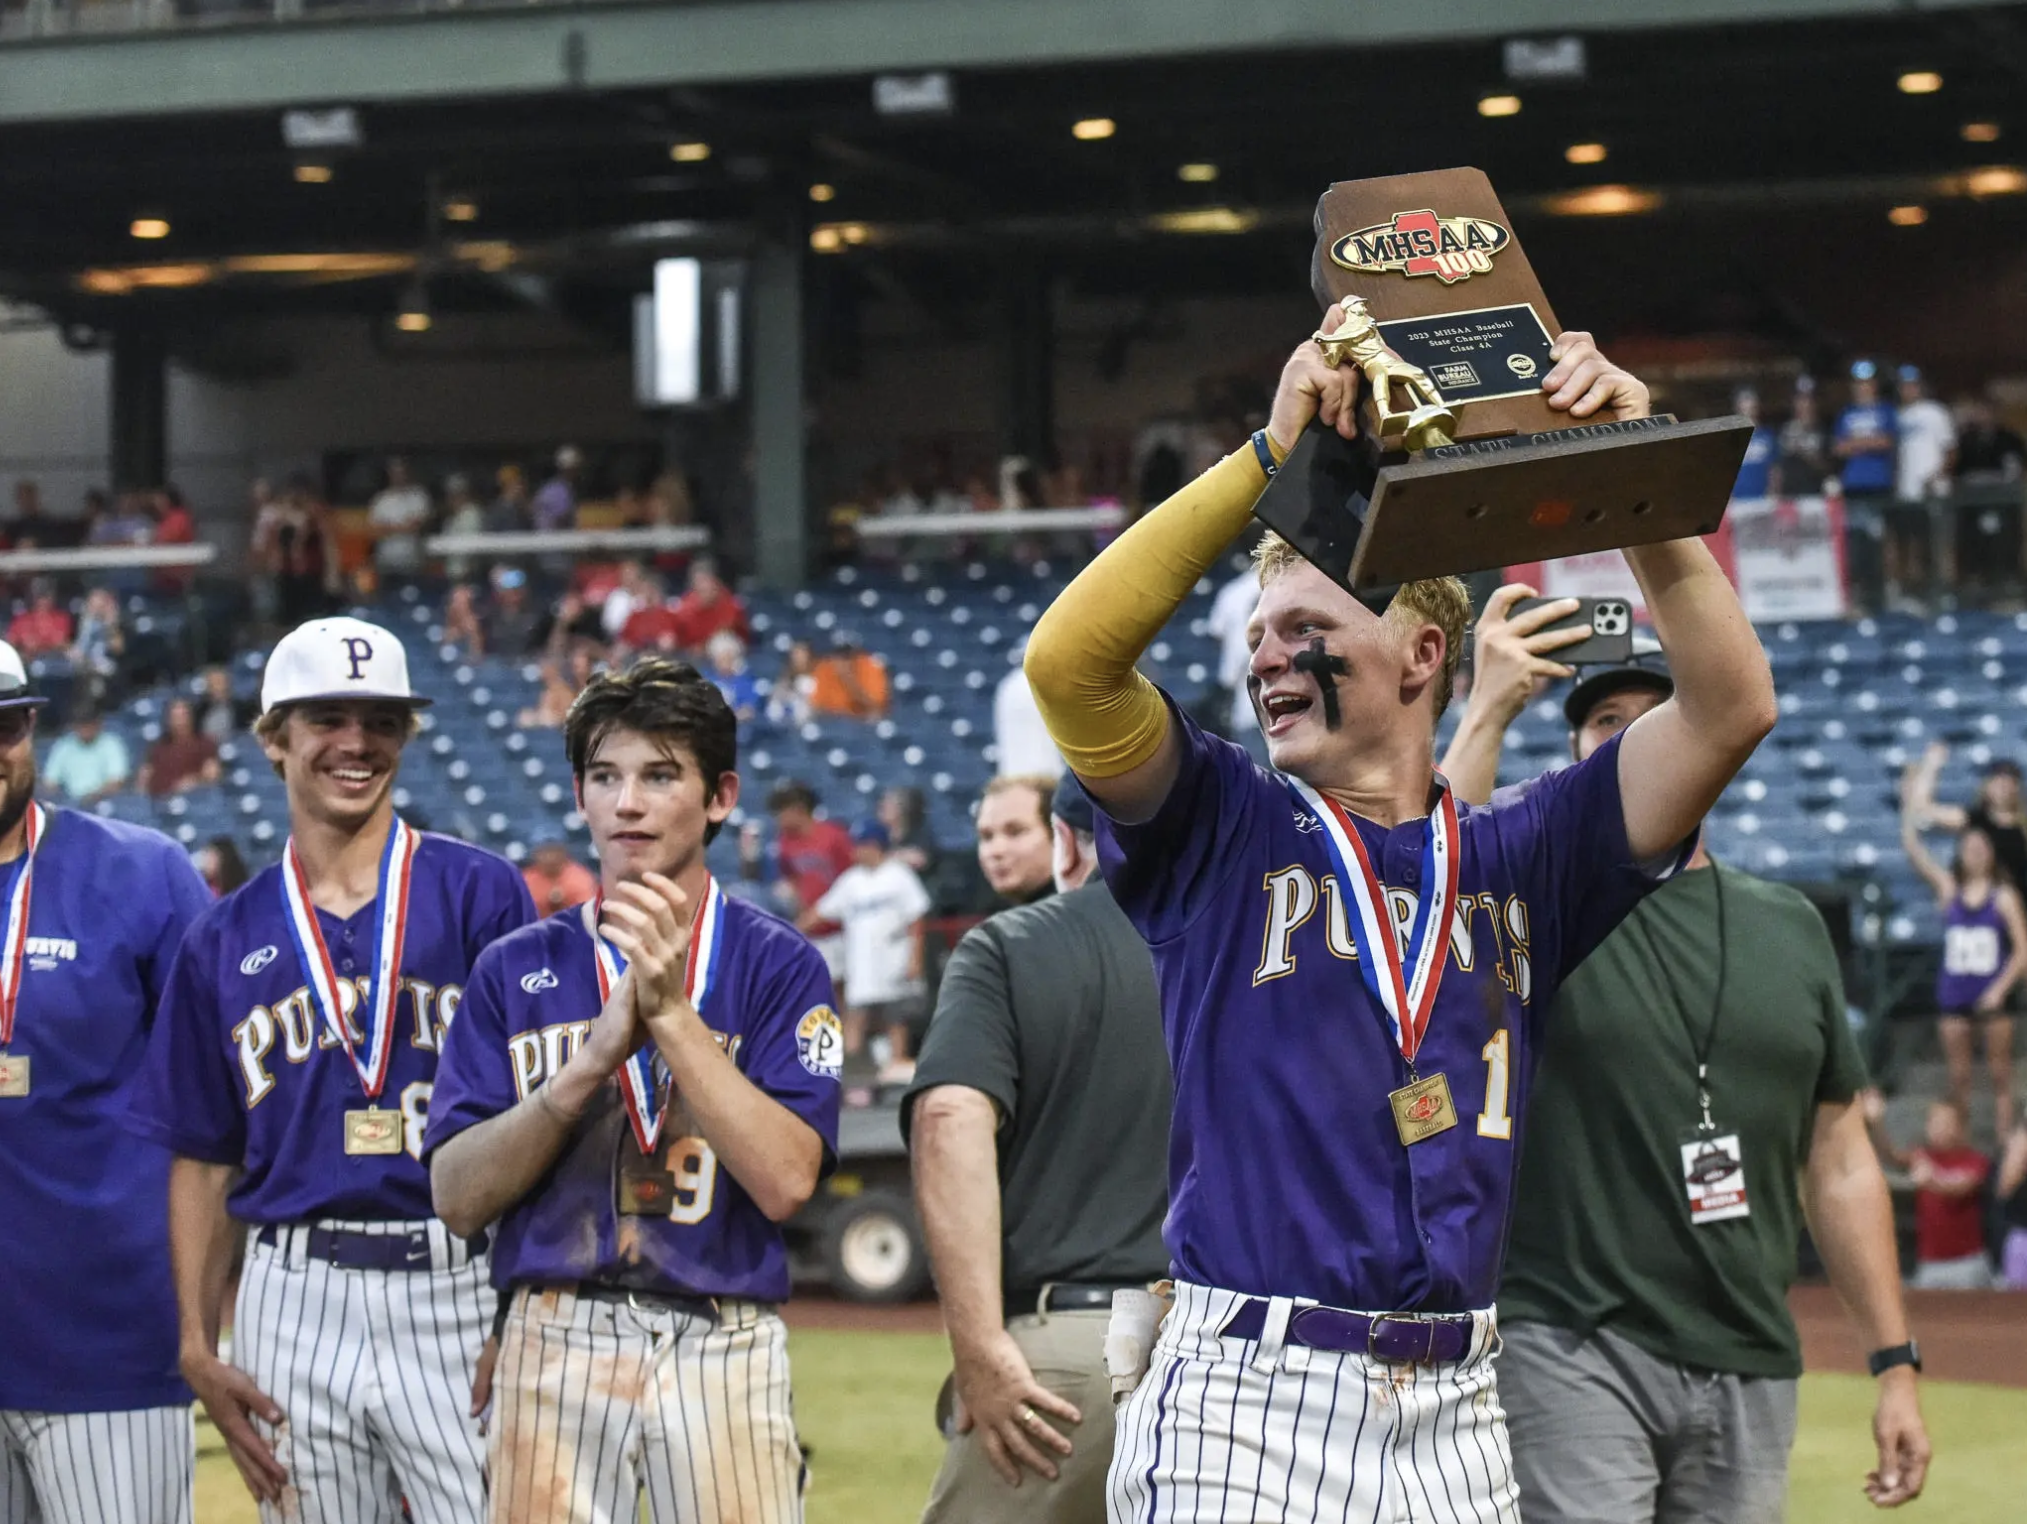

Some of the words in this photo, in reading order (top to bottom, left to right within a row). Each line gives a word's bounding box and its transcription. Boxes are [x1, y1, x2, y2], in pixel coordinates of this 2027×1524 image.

[1352, 222, 1494, 266] MHSAA
[1432, 249, 1490, 274] 100
[1407, 332, 1430, 341] 2023
[1433, 326, 1472, 337] MHSAA
[1475, 320, 1514, 332] Baseball
[1429, 338, 1451, 347] State
[1455, 332, 1503, 344] Champion
[1450, 344, 1475, 353] Class
[1437, 370, 1473, 382] BUREAU
[1443, 364, 1469, 373] FARM
[341, 637, 373, 679] P
[816, 1025, 834, 1061] P
[1477, 1029, 1511, 1140] 1
[666, 1136, 716, 1224] 9
